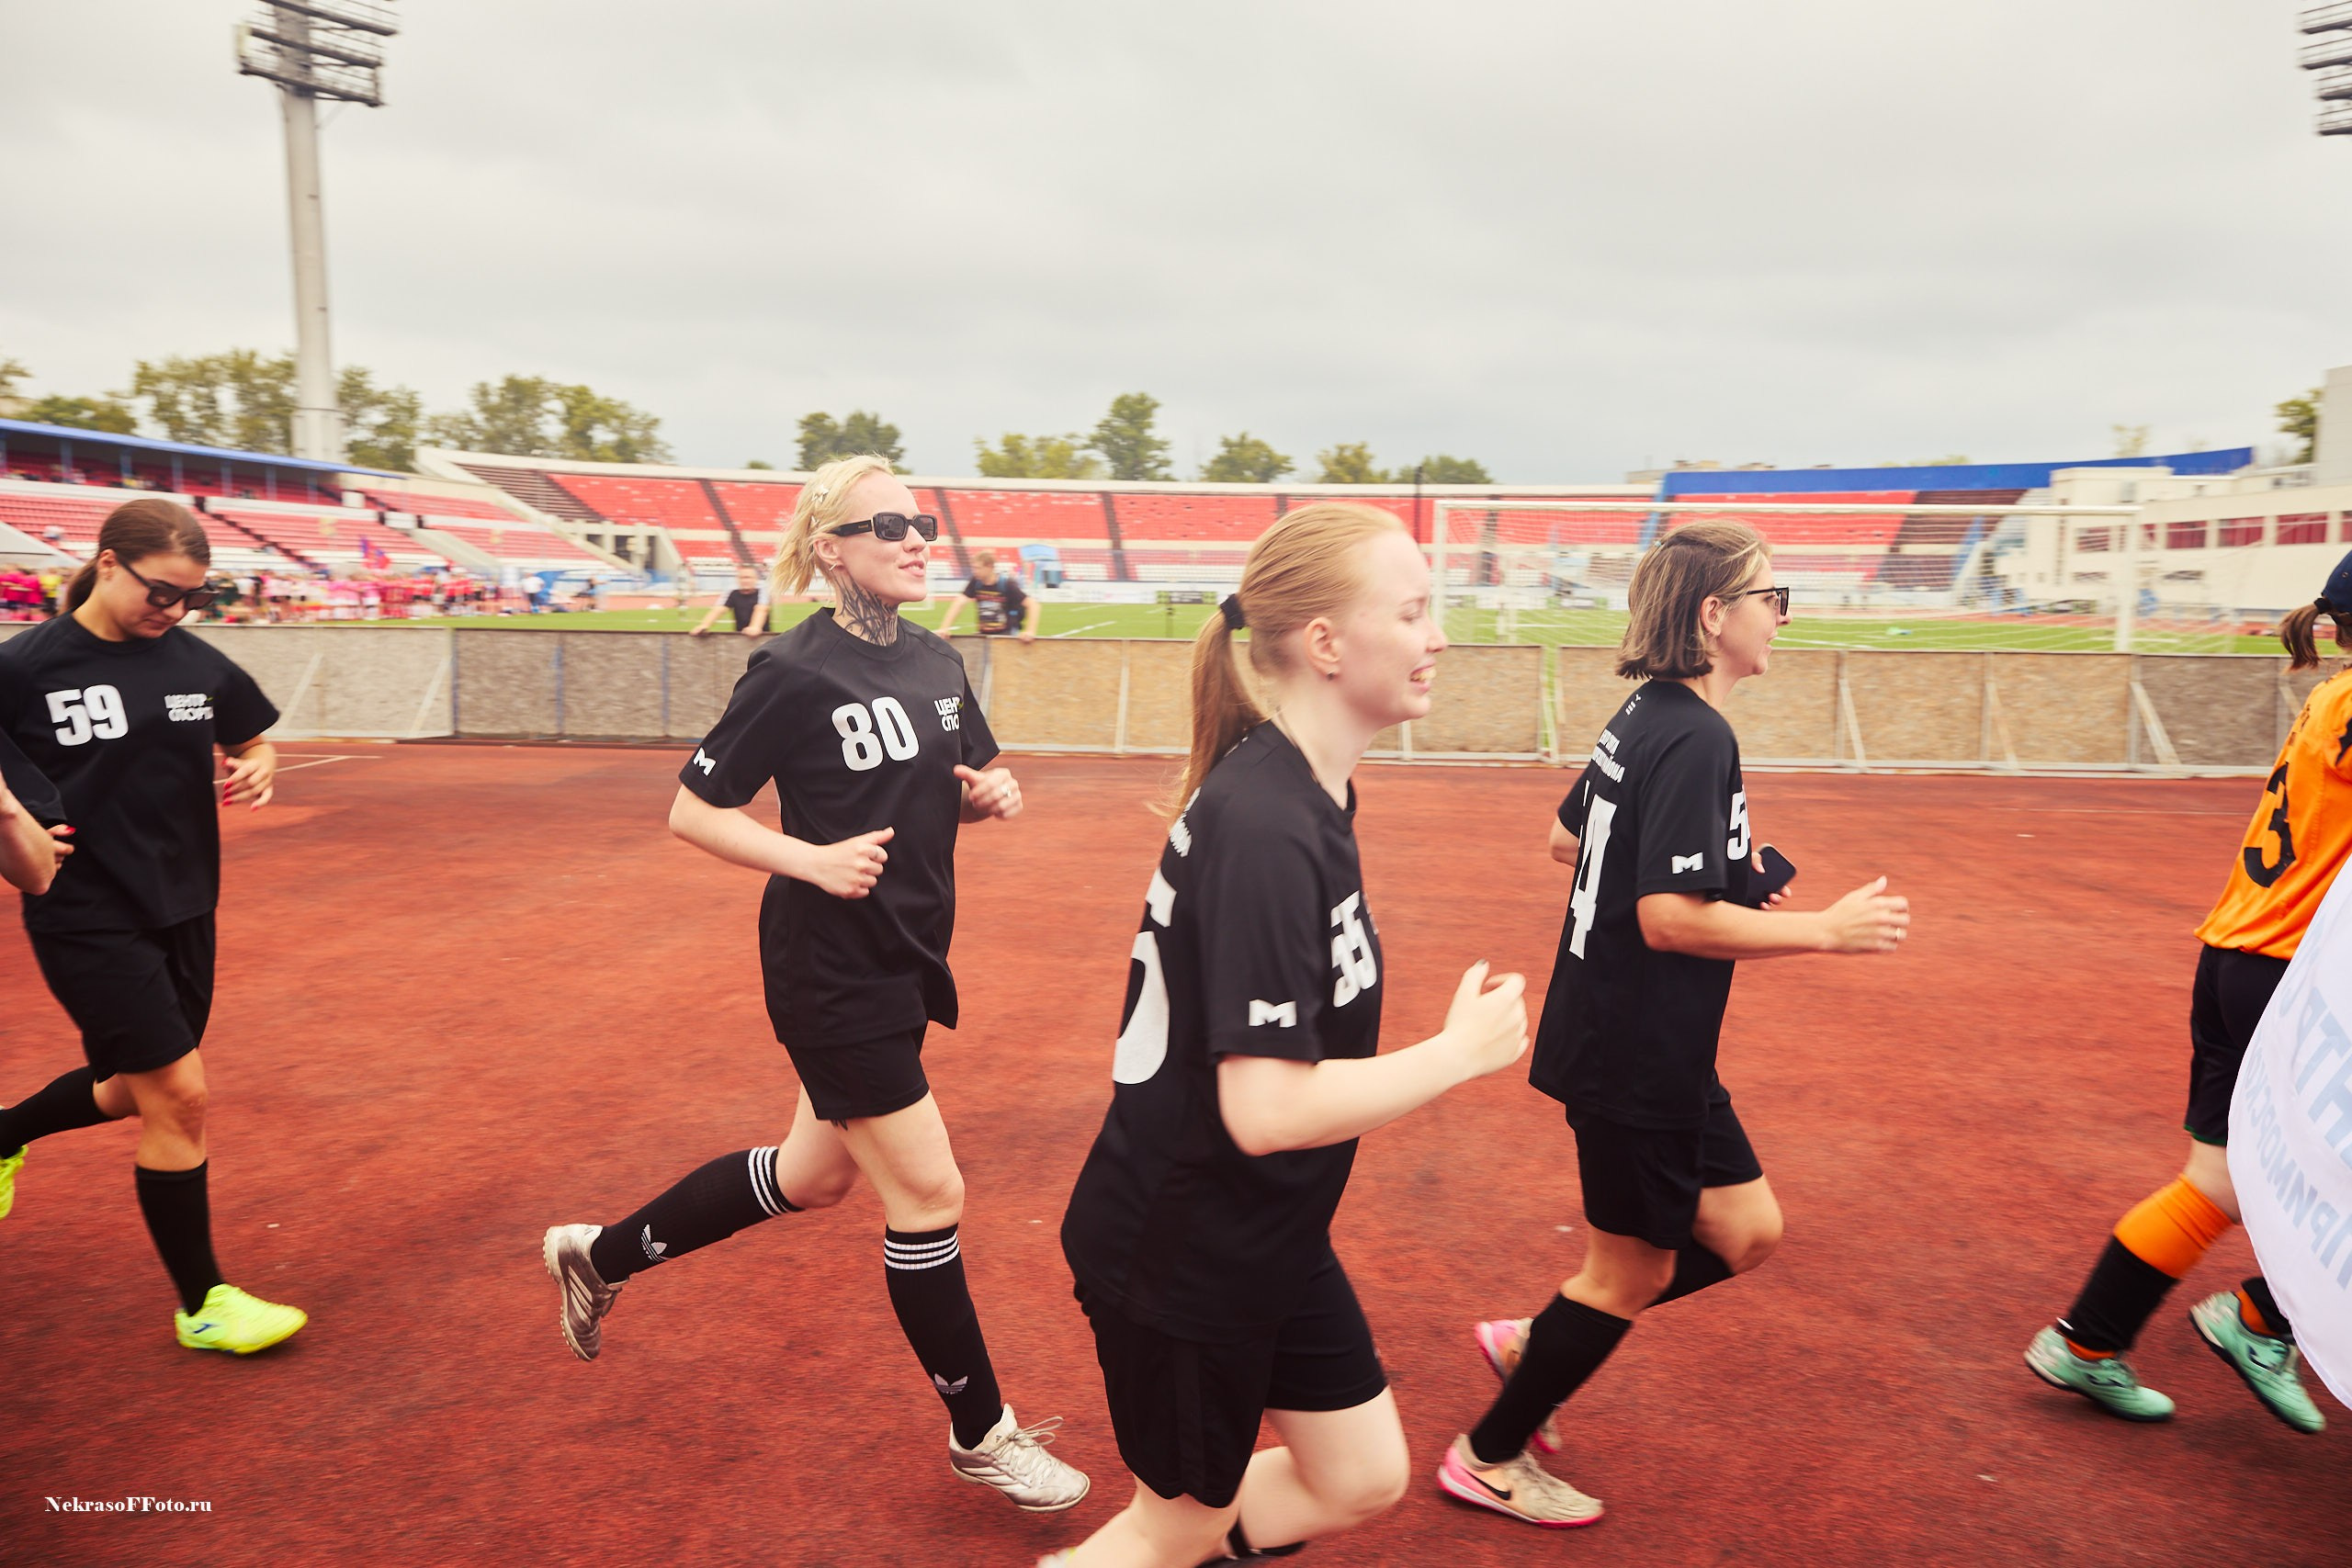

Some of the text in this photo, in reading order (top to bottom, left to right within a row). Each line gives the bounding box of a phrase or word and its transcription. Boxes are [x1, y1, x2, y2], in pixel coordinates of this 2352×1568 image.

[45, 684, 129, 746] 59
[831, 696, 919, 771] 80
[1727, 784, 1751, 861] 5
[1569, 780, 1618, 961] 4
